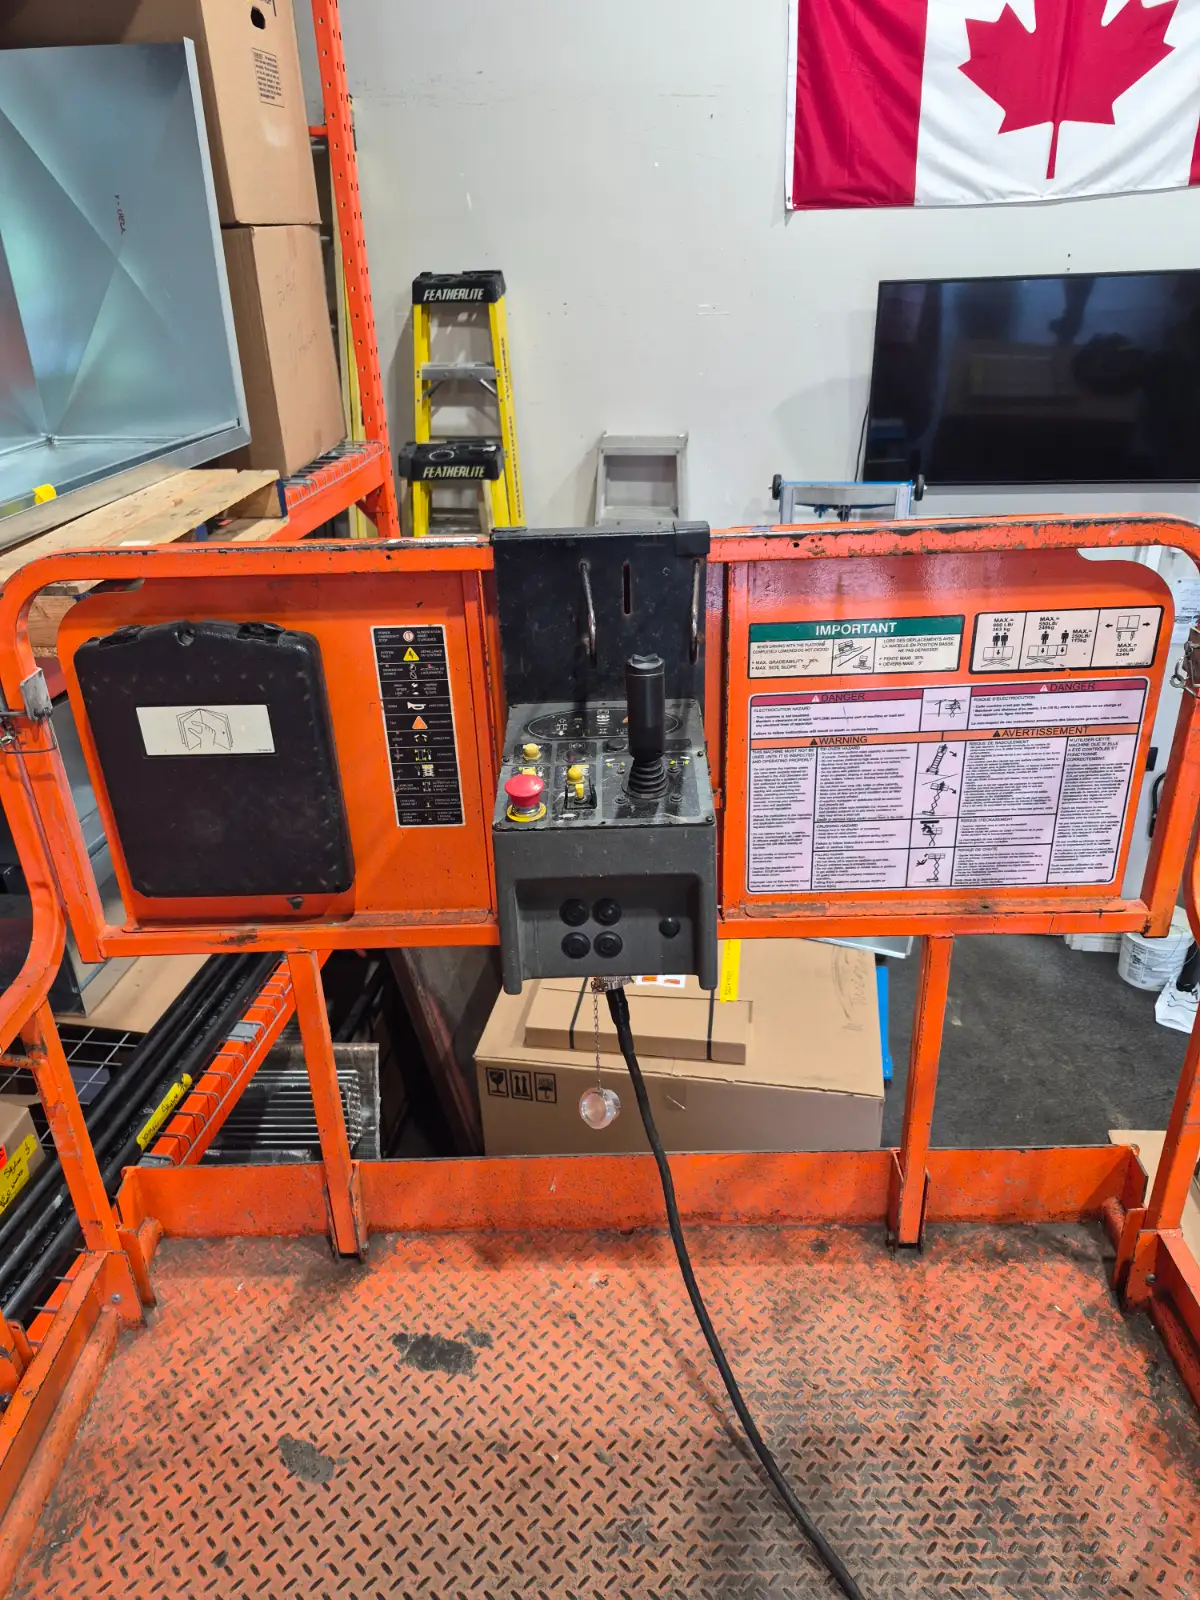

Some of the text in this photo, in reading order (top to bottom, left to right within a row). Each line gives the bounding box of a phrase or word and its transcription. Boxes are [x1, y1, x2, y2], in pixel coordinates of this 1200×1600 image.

[423, 288, 485, 301] FEATHERLITE
[422, 465, 486, 478] FEATHERLITE
[815, 621, 897, 636] IMPORTANT
[1050, 682, 1096, 692] DANGER
[821, 693, 865, 702] DANGER
[1002, 726, 1089, 737] AVERTISSEMENT
[819, 735, 868, 745] WARNING
